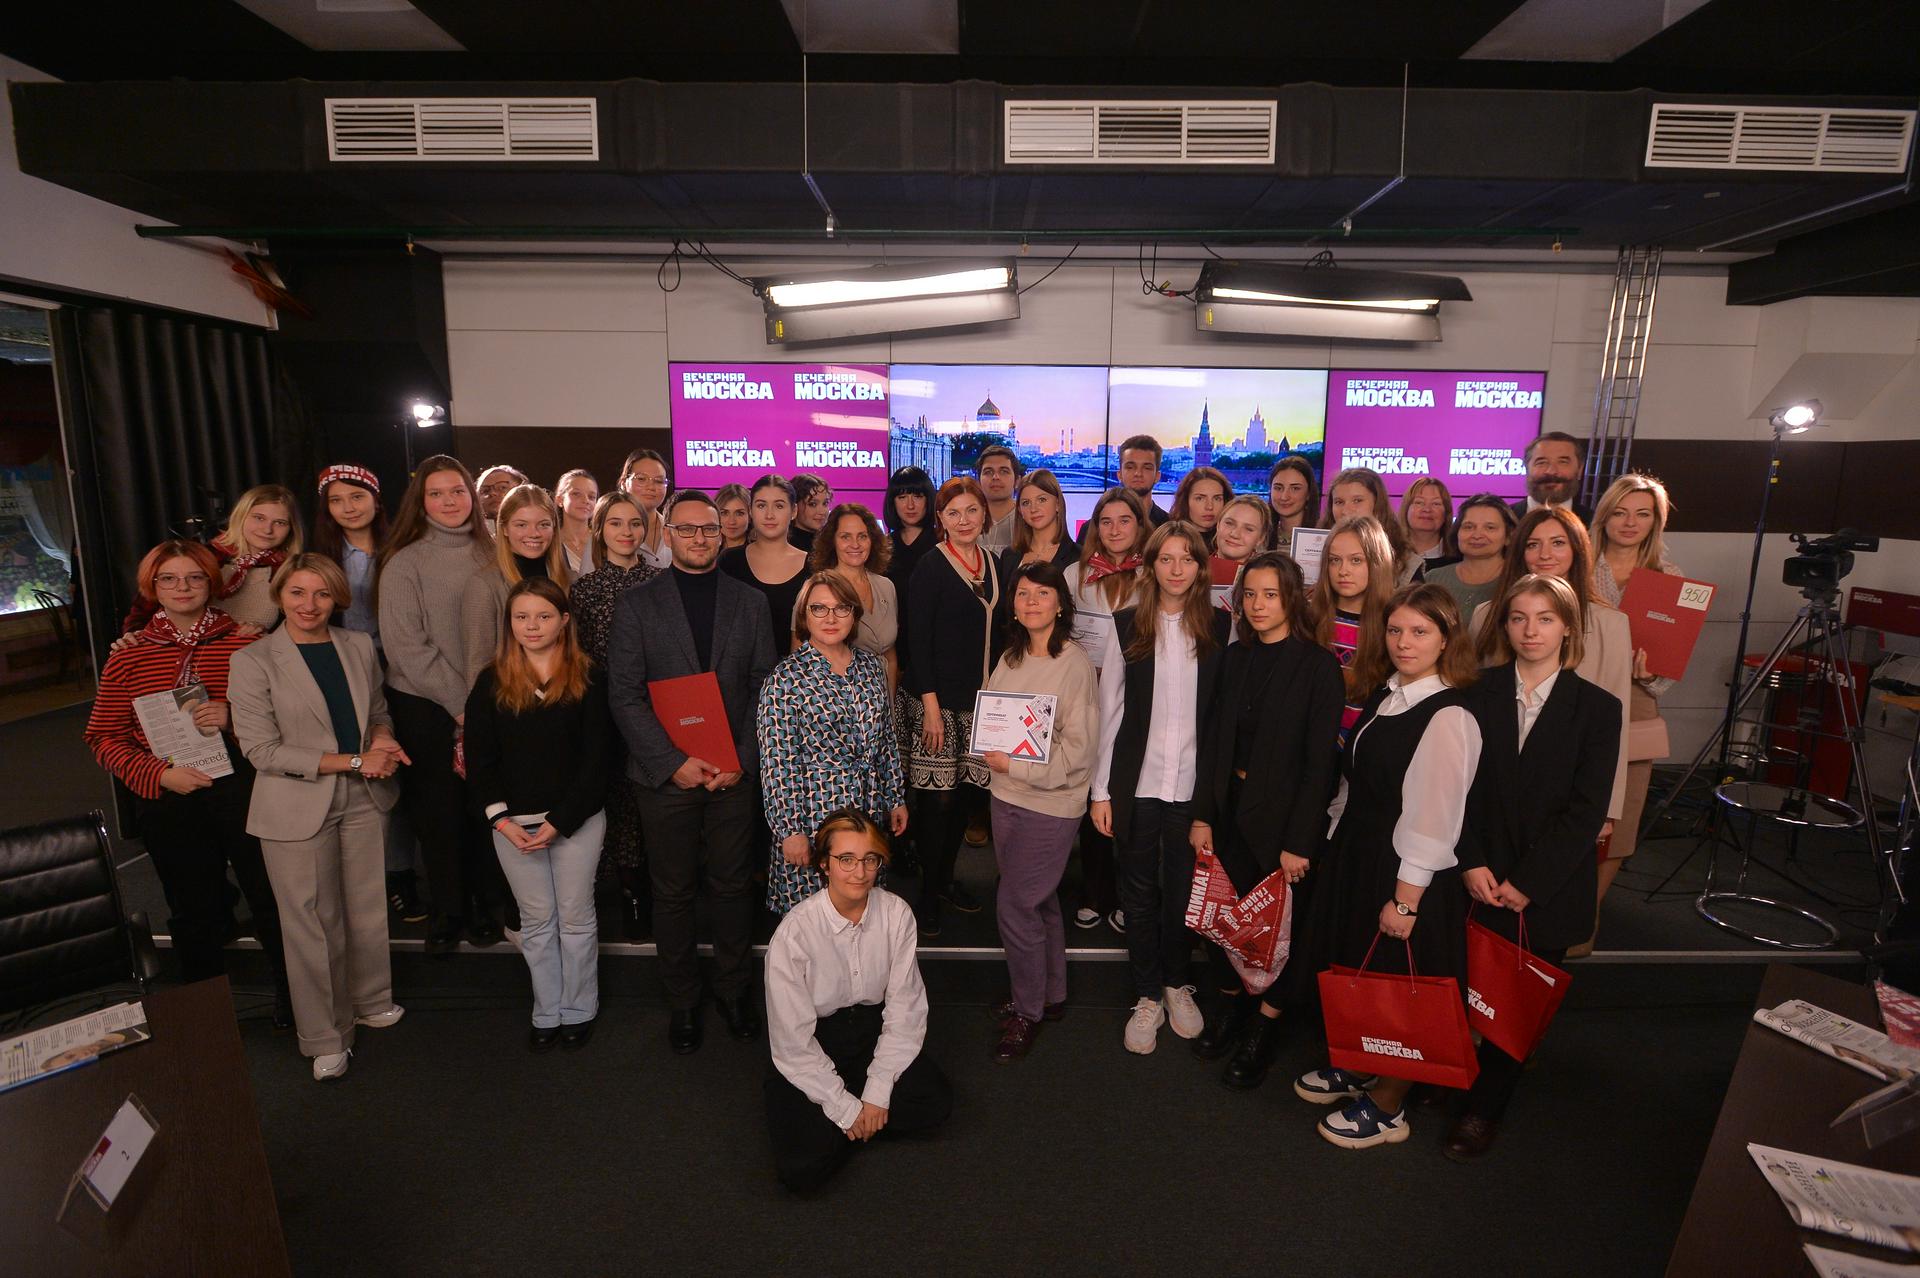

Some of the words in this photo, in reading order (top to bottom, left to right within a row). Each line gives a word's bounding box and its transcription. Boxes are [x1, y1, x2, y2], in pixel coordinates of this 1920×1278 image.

[683, 373, 745, 381] ВЕЧЕРНЯЯ
[794, 373, 856, 382] ВЕЧЕРНЯЯ
[1347, 380, 1408, 389] ВЕЧЕРНЯЯ
[683, 382, 774, 400] МОСКВА
[794, 383, 885, 400] МОСКВА
[1456, 381, 1518, 390] ВЕЧЕРНЯЯ
[1345, 390, 1435, 407] МОСКВА
[1455, 391, 1543, 408] МОСКВА
[686, 441, 747, 449] ВЕЧЕРНЯЯ
[796, 442, 857, 450] ВЕЧЕРНЯЯ
[1342, 448, 1403, 457] ВЕЧЕРНЯЯ
[686, 450, 776, 467] МОСКВА
[796, 451, 885, 468] МОСКВА
[1450, 449, 1511, 458] ВЕЧЕРНЯЯ
[1449, 458, 1527, 475] МОСКВ
[1681, 588, 1710, 604] 950
[1467, 994, 1496, 1020] КВА
[1361, 1036, 1402, 1047] ВЕЧЕРНЯЯ
[1362, 1042, 1424, 1061] МОСКВА
